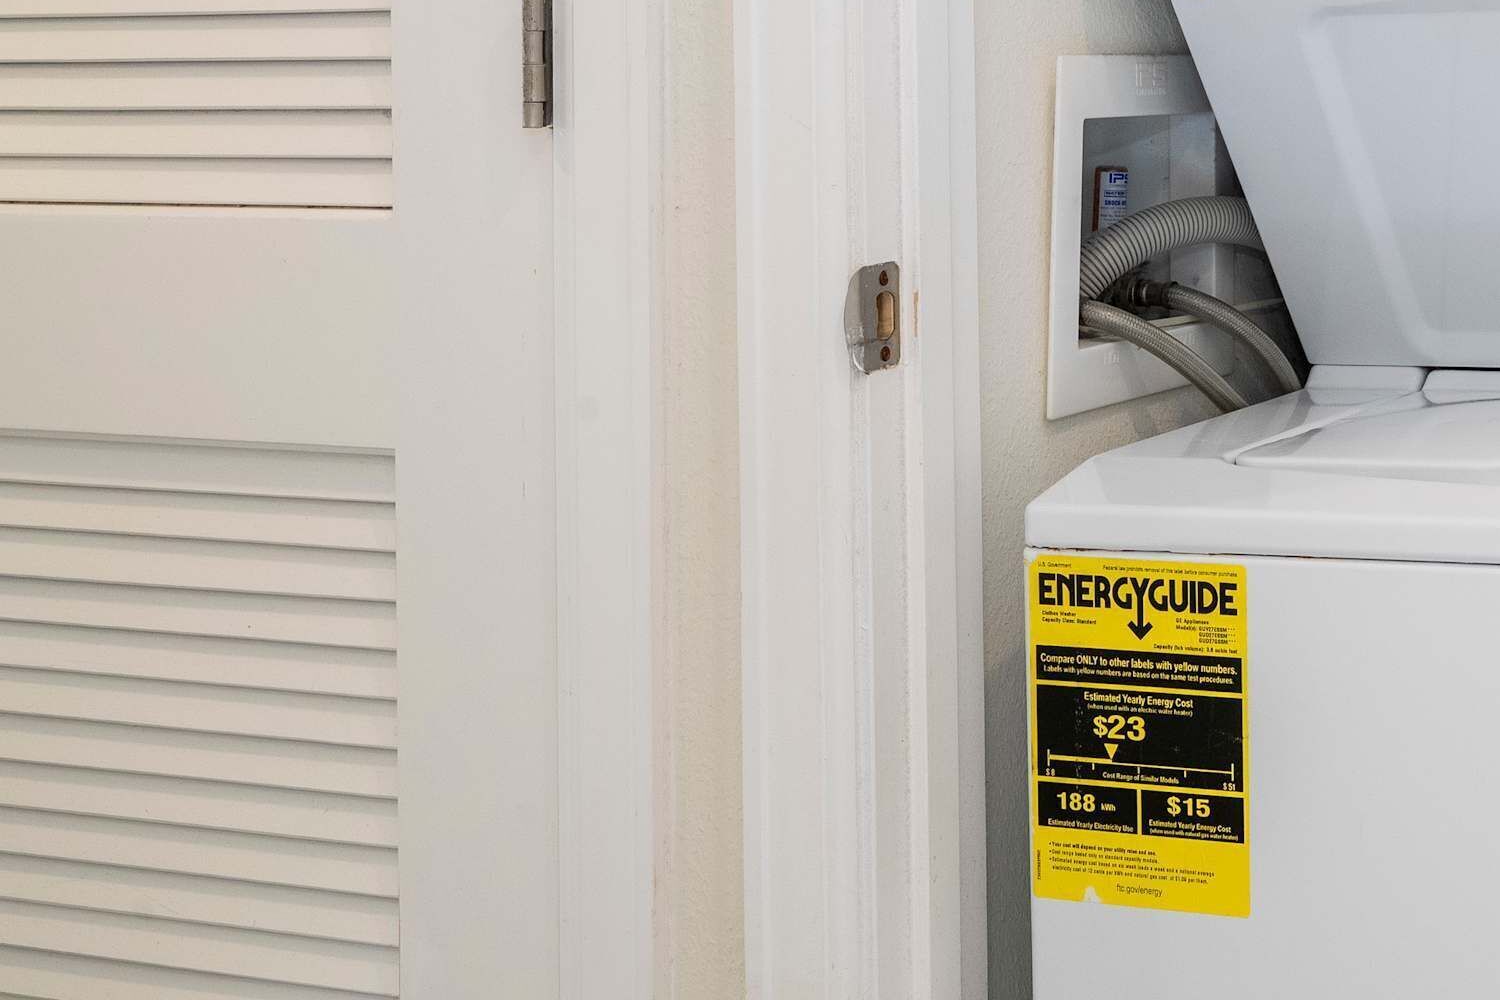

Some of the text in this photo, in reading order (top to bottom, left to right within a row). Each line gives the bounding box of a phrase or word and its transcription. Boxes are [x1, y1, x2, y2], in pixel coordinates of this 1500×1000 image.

[1038, 572, 1238, 617] ENERGYGUIDE
[1040, 653, 1238, 675] Compare ONLY to other labels with yellow numbers.
[1084, 691, 1193, 708] Estimated Yearly Energy Cost
[1093, 715, 1146, 741] $23
[1056, 792, 1116, 812] 188 kWh
[1166, 796, 1211, 818] $15
[1047, 818, 1075, 827] Estimated
[1076, 820, 1093, 829] Yearly
[1148, 819, 1231, 833] Estimated Yearly Energy Cost
